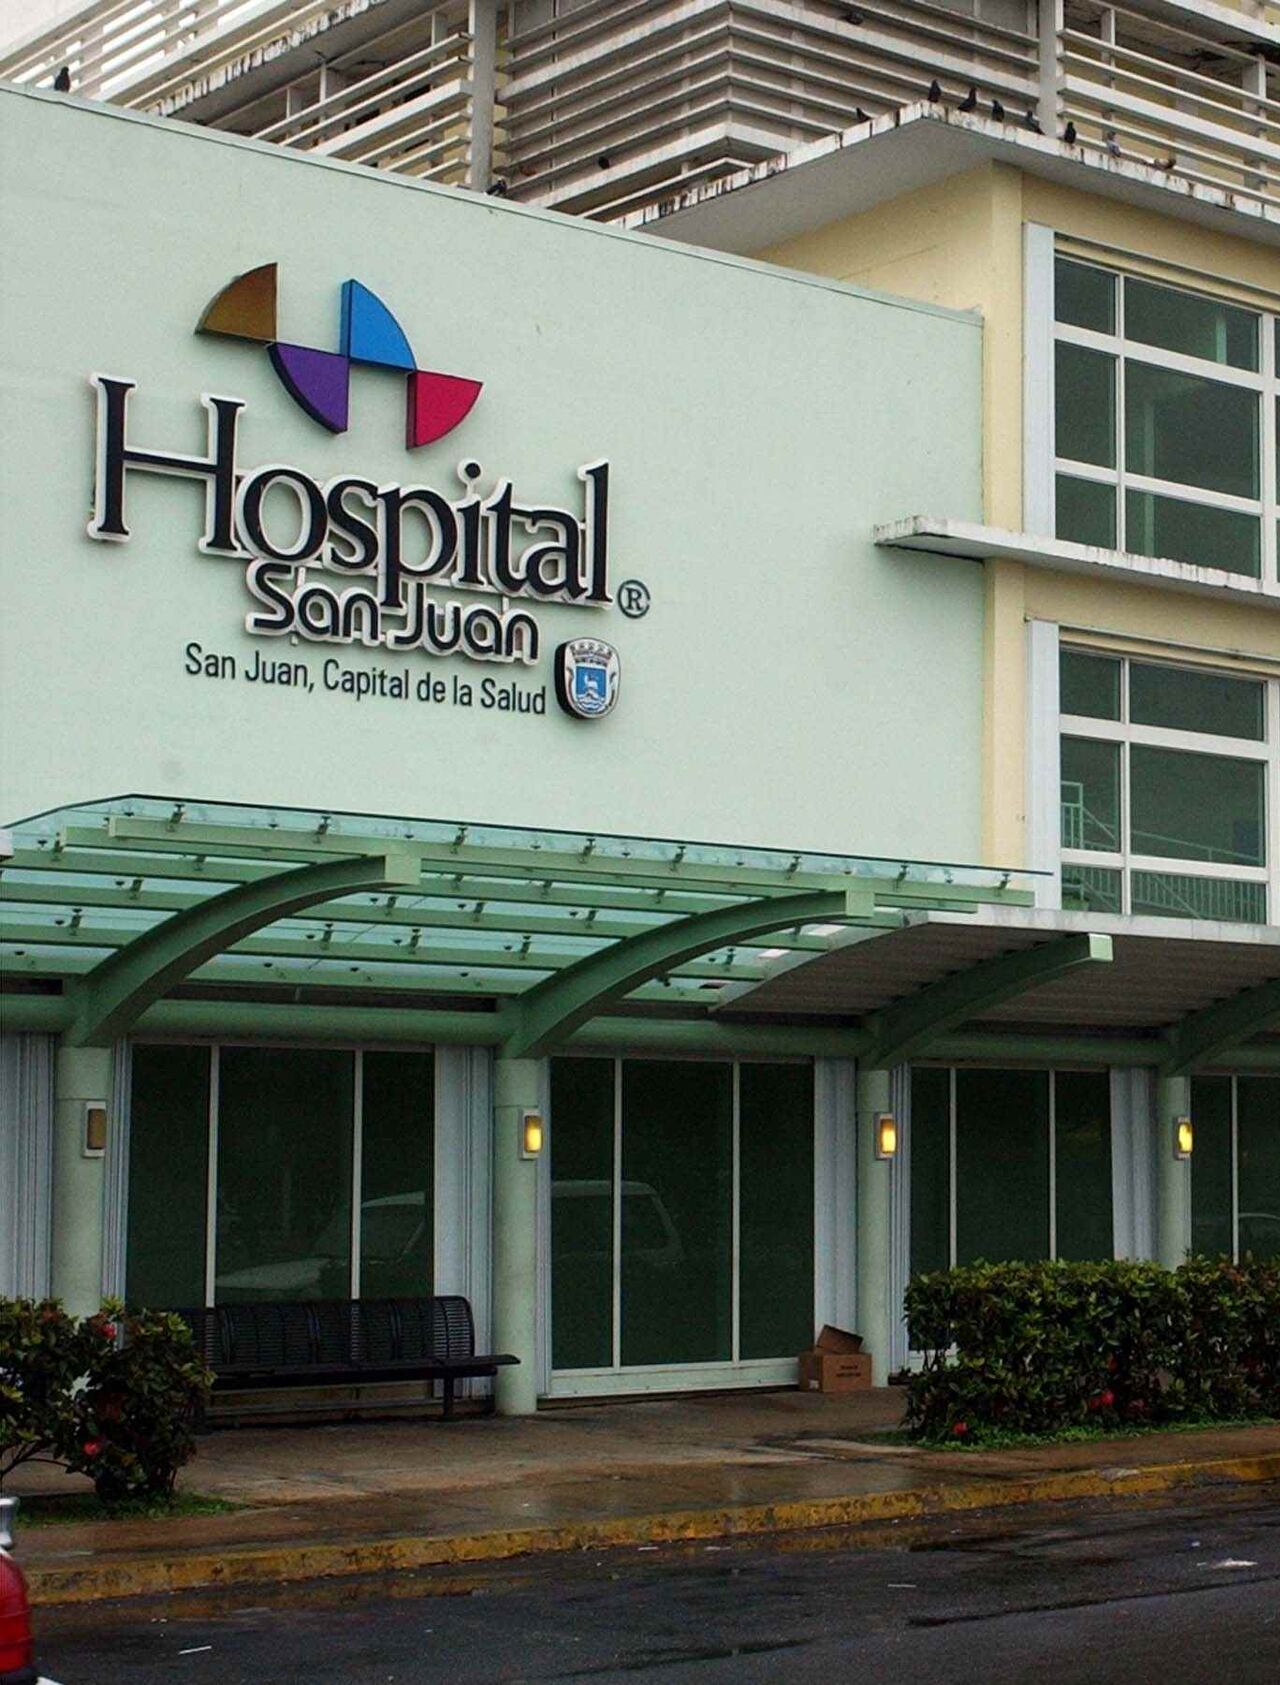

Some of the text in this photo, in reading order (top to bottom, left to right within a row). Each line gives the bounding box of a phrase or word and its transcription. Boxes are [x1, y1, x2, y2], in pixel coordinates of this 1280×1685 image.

[92, 374, 613, 609] Hospital
[252, 562, 540, 660] San Juan
[185, 642, 546, 715] San Juan, Capital de la Salud
